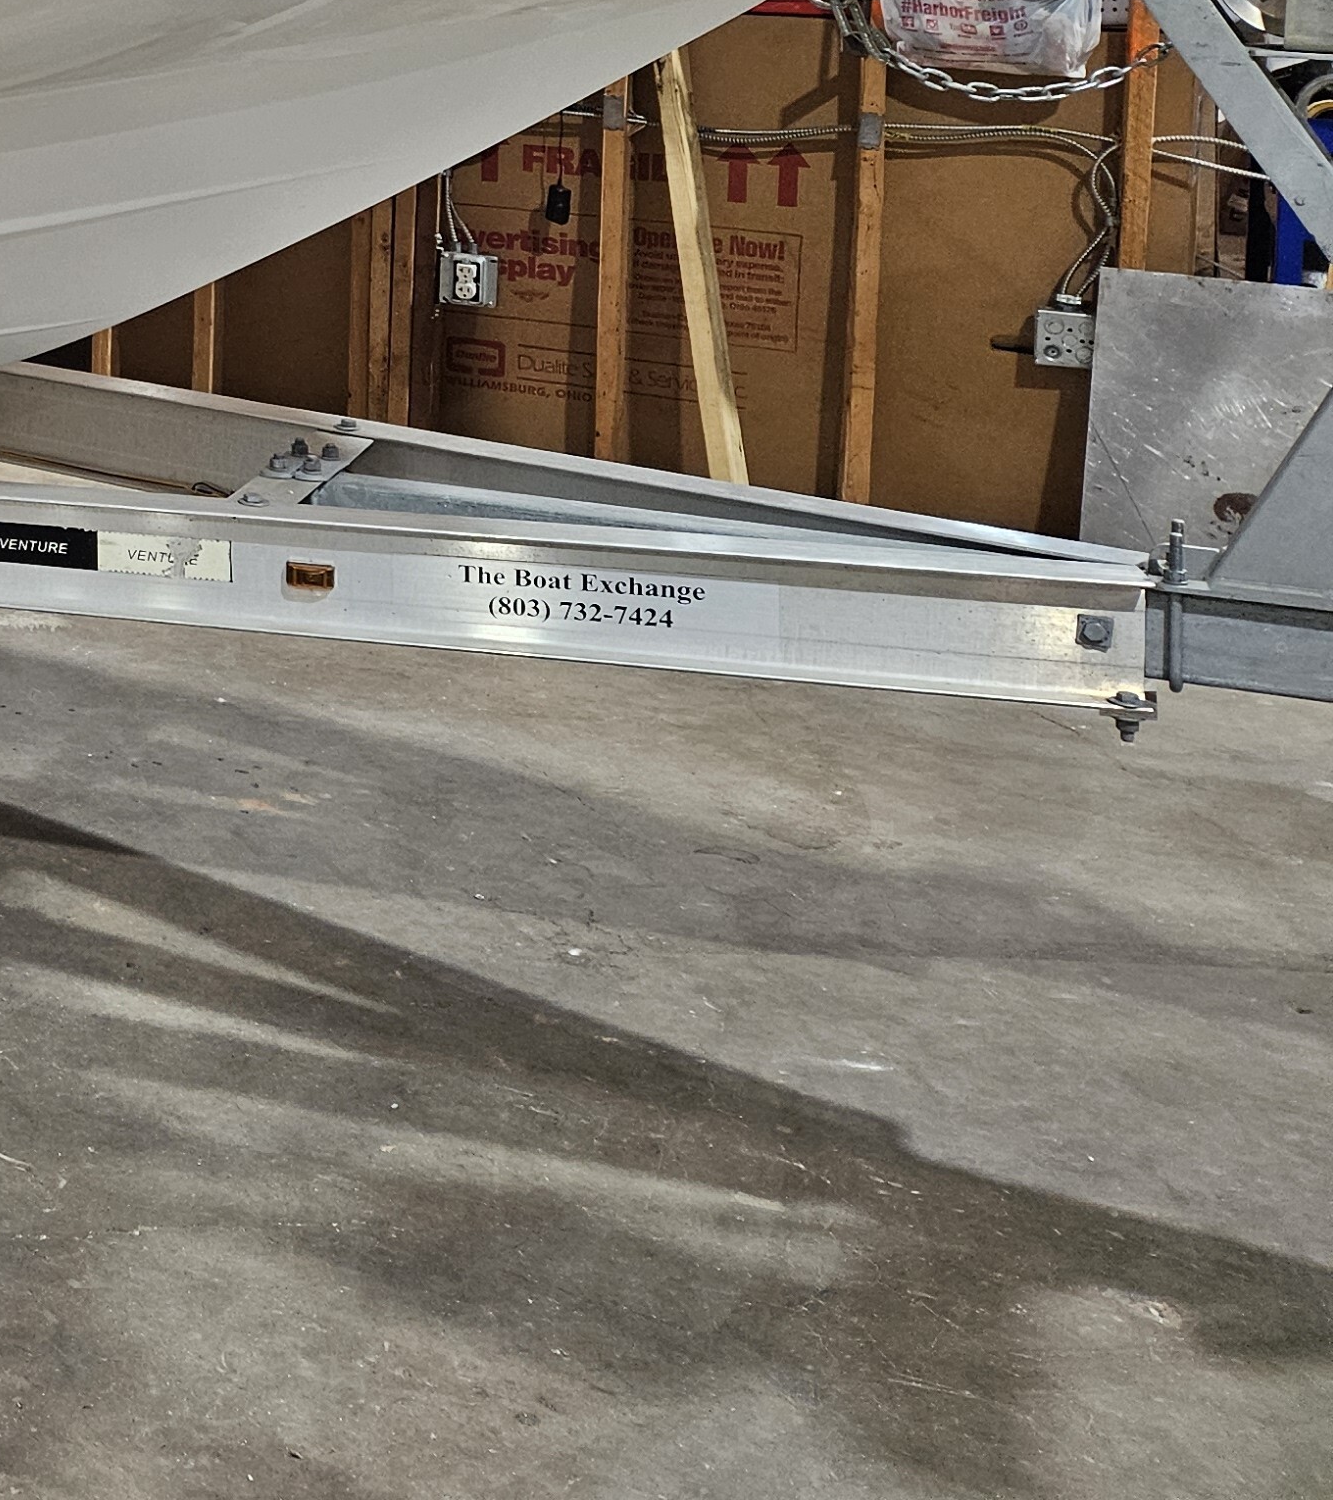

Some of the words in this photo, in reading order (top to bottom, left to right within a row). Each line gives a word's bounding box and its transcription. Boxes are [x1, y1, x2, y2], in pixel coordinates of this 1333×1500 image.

[729, 235, 786, 261] Now!
[517, 354, 576, 377] Dualite
[555, 388, 593, 402] OHIO
[0, 537, 68, 555] VENTURE
[458, 564, 506, 585] The
[514, 568, 572, 590] Boat
[581, 573, 706, 605] Exchange
[488, 595, 551, 622] (803)
[559, 601, 674, 628] 732-7424
